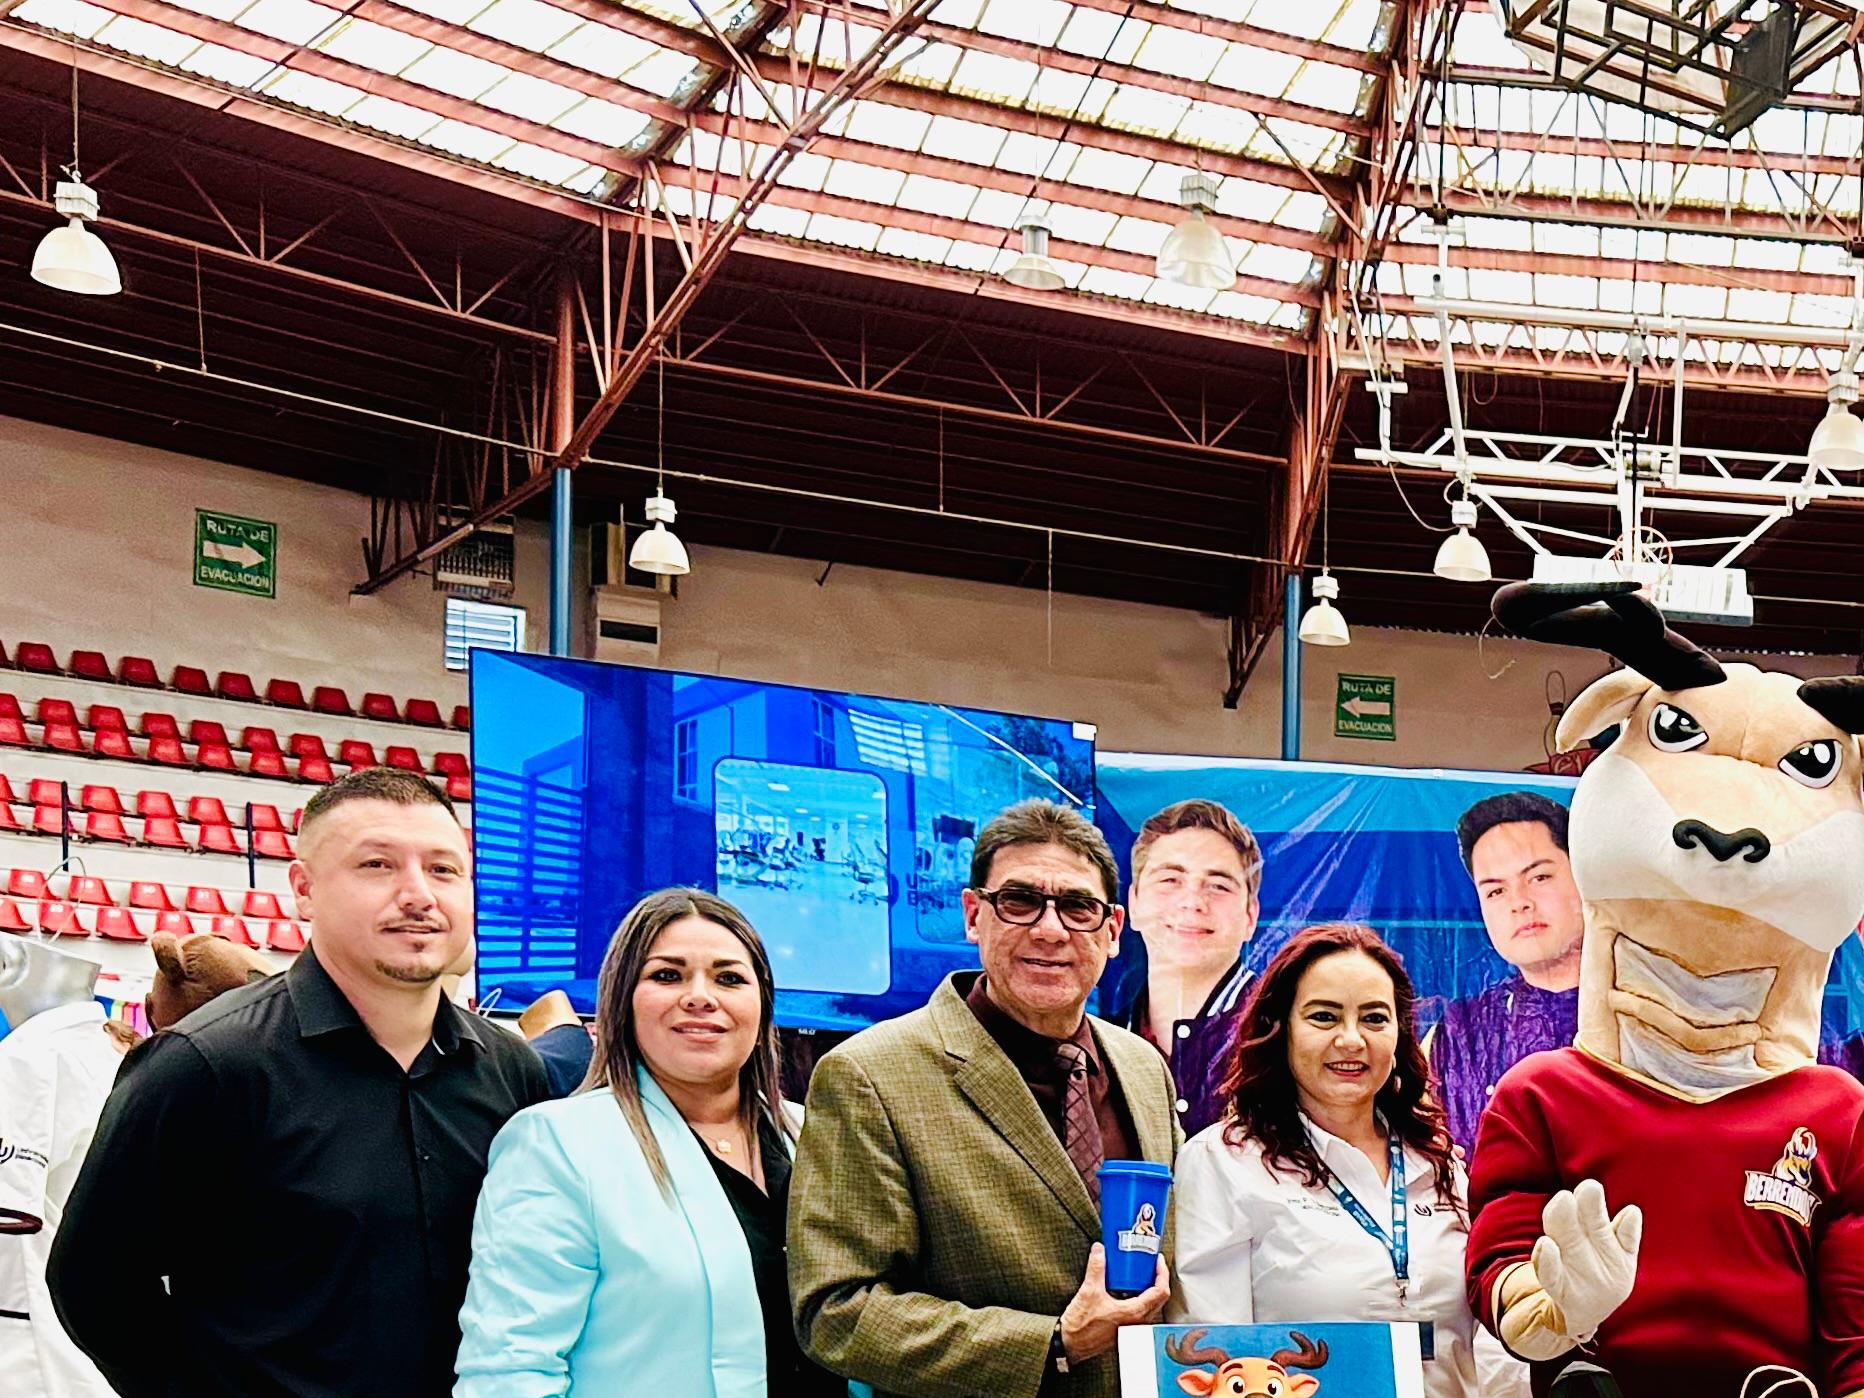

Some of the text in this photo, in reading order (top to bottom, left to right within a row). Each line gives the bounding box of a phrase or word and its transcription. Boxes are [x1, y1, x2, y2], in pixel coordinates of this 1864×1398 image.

[206, 519, 269, 543] RUTA DE
[200, 565, 270, 588] EVACUACION
[1341, 681, 1392, 695] RUTA DE
[1338, 719, 1393, 733] EVACUACION
